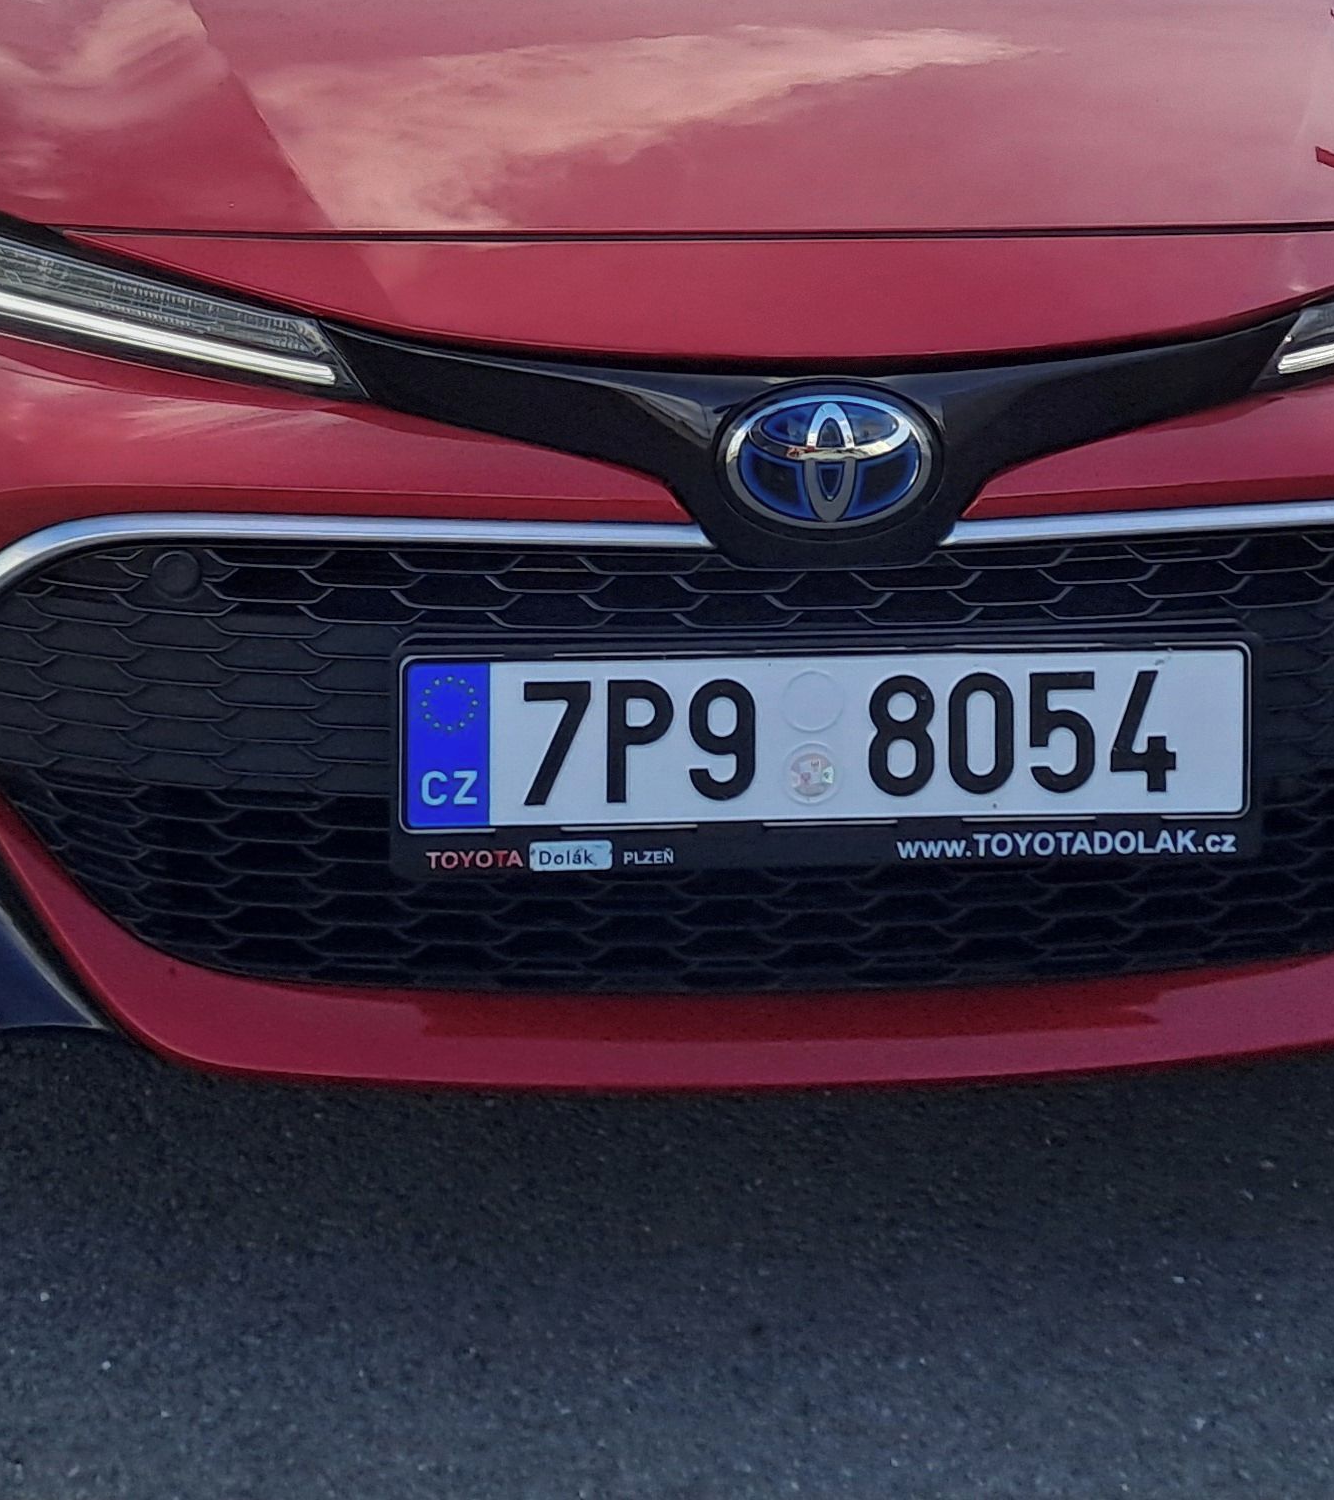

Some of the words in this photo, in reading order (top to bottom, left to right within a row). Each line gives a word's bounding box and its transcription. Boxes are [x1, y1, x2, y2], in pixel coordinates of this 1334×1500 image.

[522, 677, 756, 806] 7P9
[868, 669, 1177, 797] 8054
[420, 770, 478, 807] CZ
[425, 850, 524, 870] TOYOTA
[538, 849, 595, 866] Dolák
[622, 847, 675, 866] PLZEŇ
[896, 829, 1237, 860] www.TOYOTADOLAK.cz
